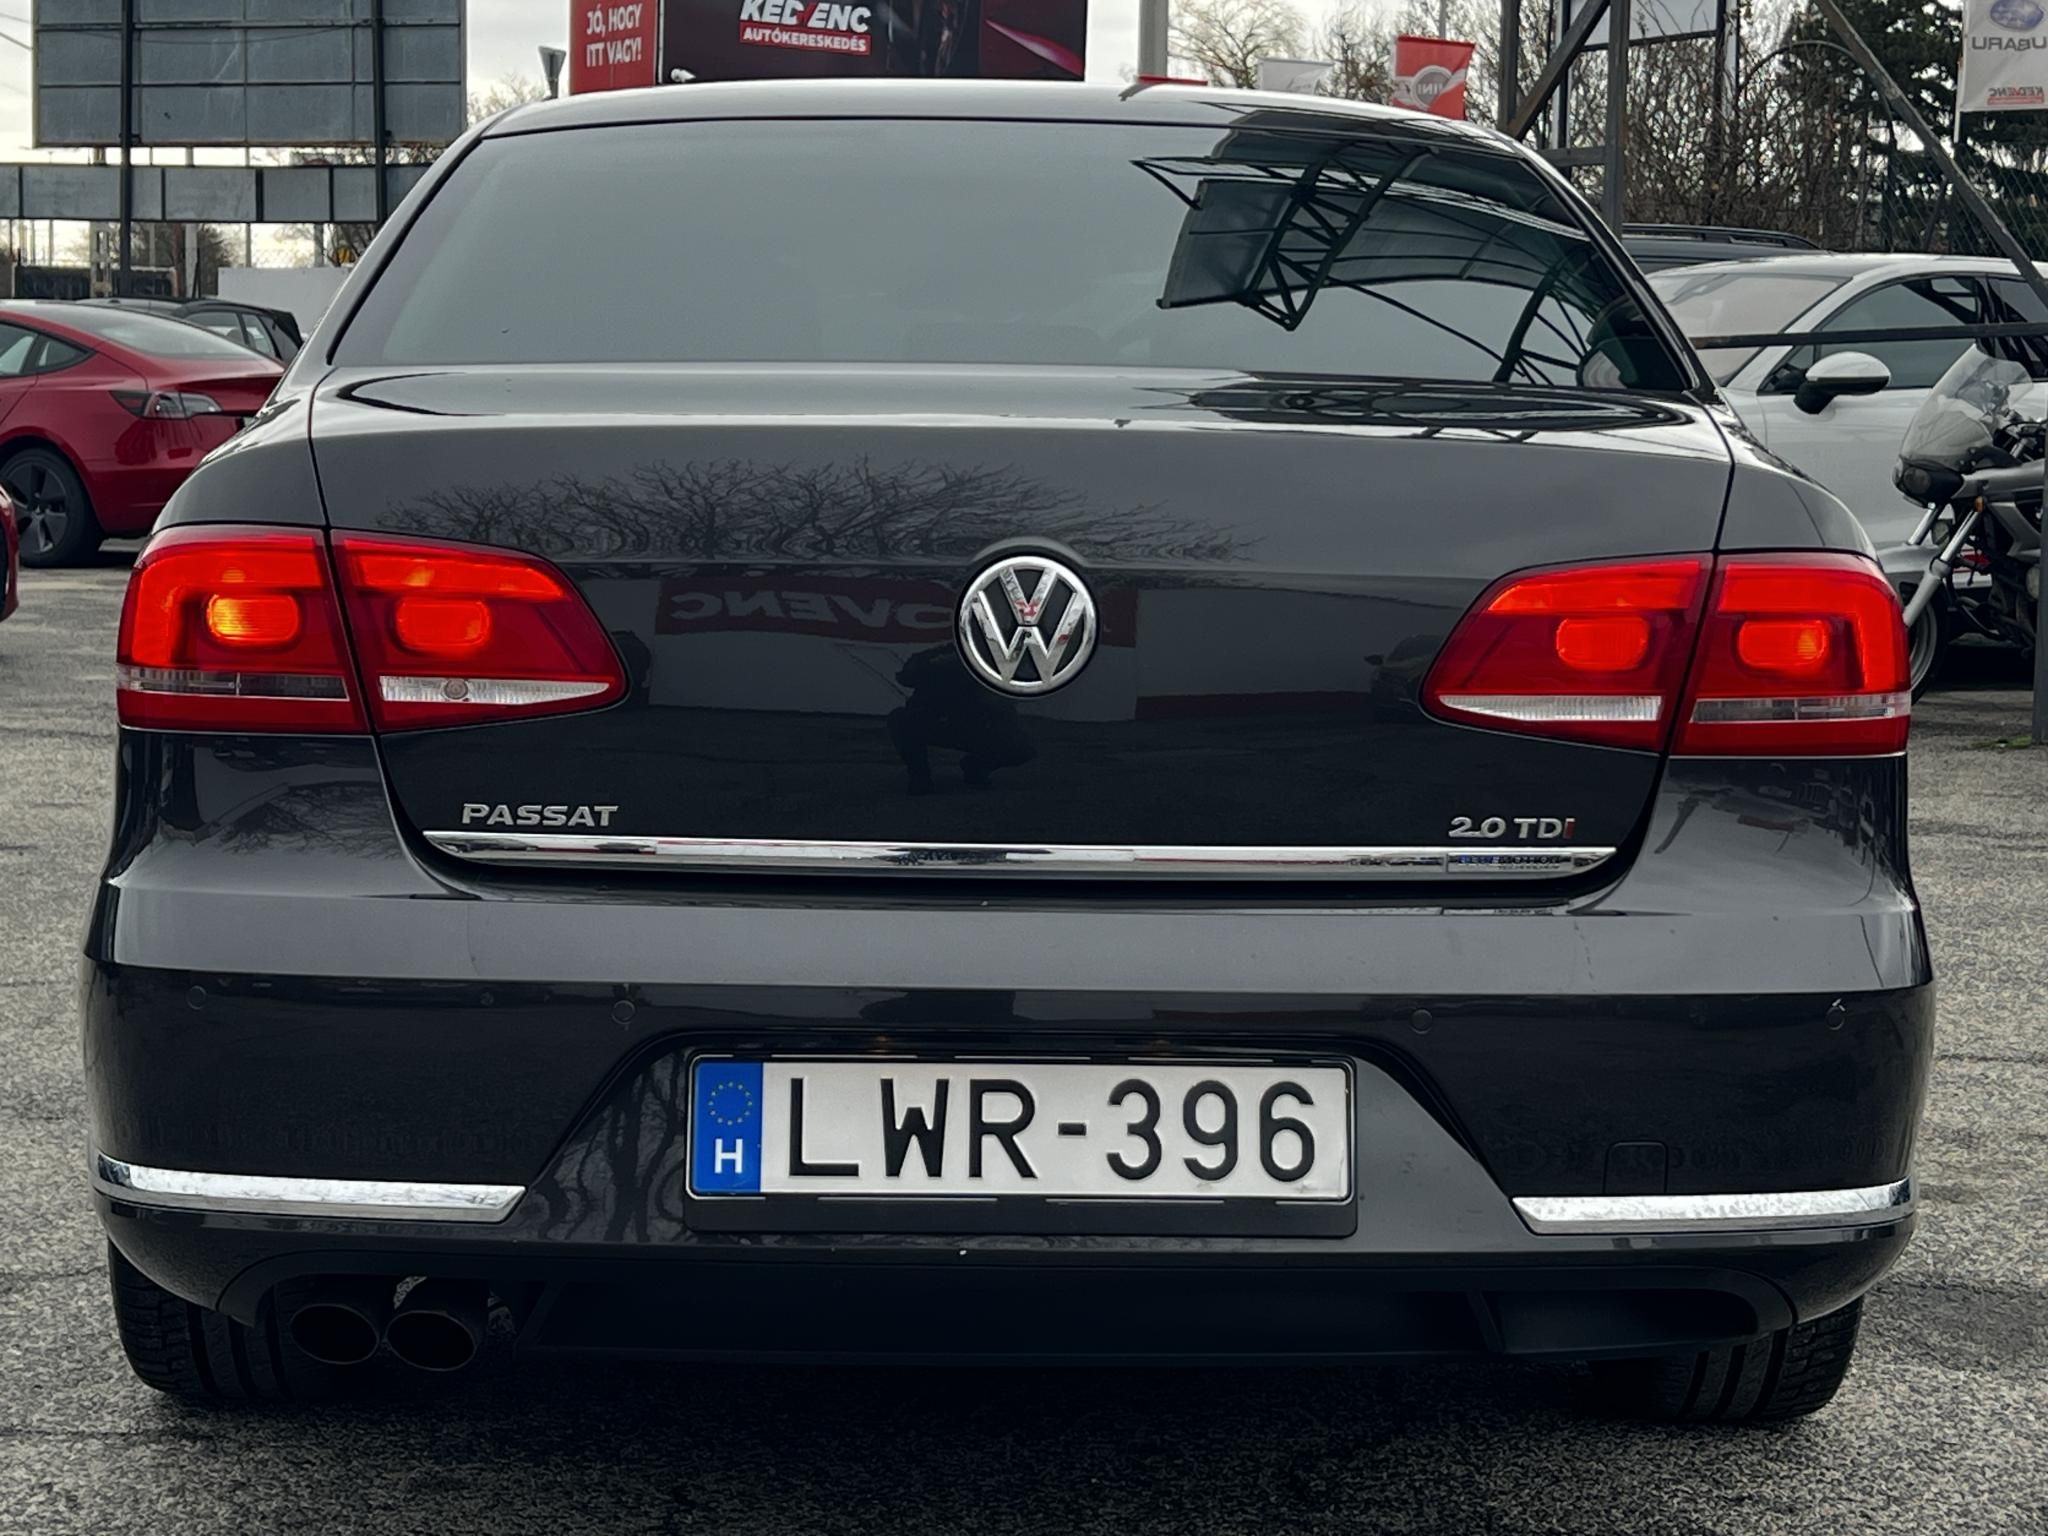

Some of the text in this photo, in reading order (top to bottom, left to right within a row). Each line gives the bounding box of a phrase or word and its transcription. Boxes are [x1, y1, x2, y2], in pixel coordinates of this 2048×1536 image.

[586, 3, 643, 38] JÓ, HOGY
[586, 36, 642, 68] ITT VAGY!
[743, 27, 867, 52] AUTÓKERESKEDÉS
[462, 803, 619, 827] PASSAT
[1448, 816, 1507, 839] 2.0
[787, 1077, 1317, 1182] LWR-396
[713, 1138, 744, 1175] H
